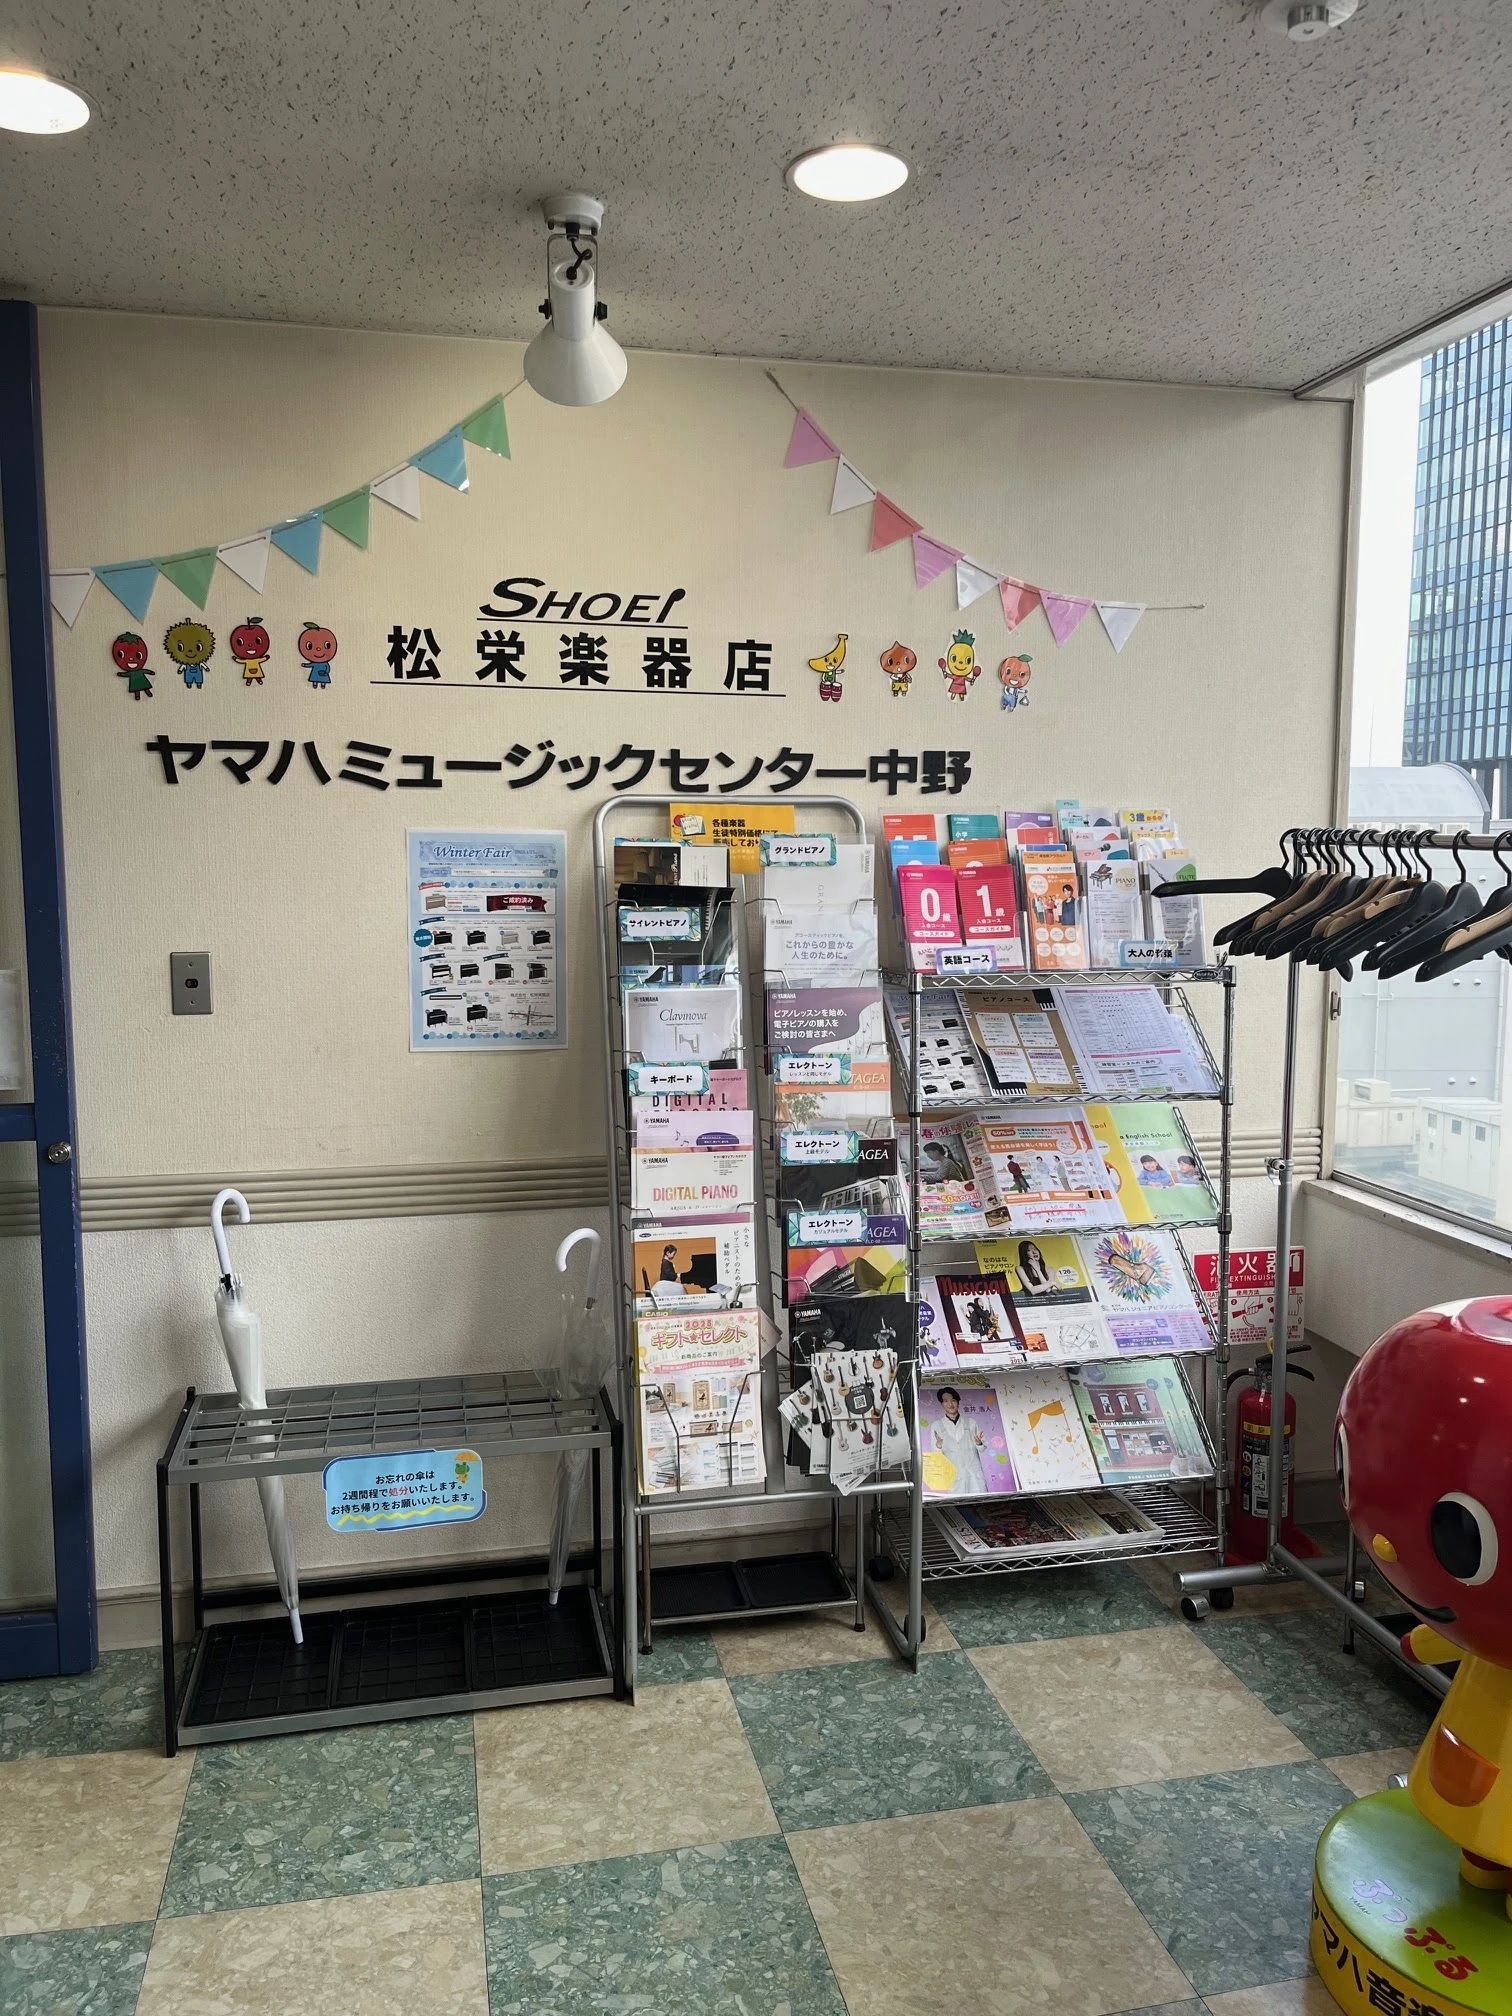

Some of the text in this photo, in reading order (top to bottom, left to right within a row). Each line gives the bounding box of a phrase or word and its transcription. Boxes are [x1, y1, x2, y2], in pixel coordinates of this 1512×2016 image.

[479, 577, 686, 623] SHOEI
[387, 626, 773, 691] 松栄楽器店
[146, 735, 971, 795] ヤマハミュージックセンター中野
[712, 819, 746, 828] 各種楽器
[433, 845, 482, 859] Winter
[483, 846, 513, 859] Fair
[775, 846, 825, 855] グランドピアノ
[1115, 877, 1136, 885] PIANO
[629, 919, 687, 927] サイレントピアノ
[785, 940, 854, 950] これからの豊かな
[791, 951, 848, 960] 人生のために。
[943, 954, 990, 965] 英語コース
[659, 1008, 708, 1022] Clavinova
[774, 1009, 848, 1018] ピアノレッスンを始め、
[774, 1019, 839, 1029] 電子ピアノの購入を
[774, 1030, 836, 1039] ご検討の皆さまへ
[650, 1075, 693, 1085] キーボード
[652, 1093, 728, 1107] DIGITAL
[1126, 1132, 1150, 1140] English
[1150, 1131, 1173, 1139] School
[795, 1140, 840, 1148] エレクトーン
[653, 1185, 698, 1202] DIGITAL
[808, 1219, 854, 1228] エレクトーン
[733, 1230, 741, 1288] ピアニストのための
[800, 1309, 822, 1317] YAMAHA
[375, 1470, 435, 1485] お忘れの傘は
[342, 1481, 463, 1501] 2週間程で処分いたします。
[331, 1492, 475, 1515] お持ち帰りをお願いいたします。
